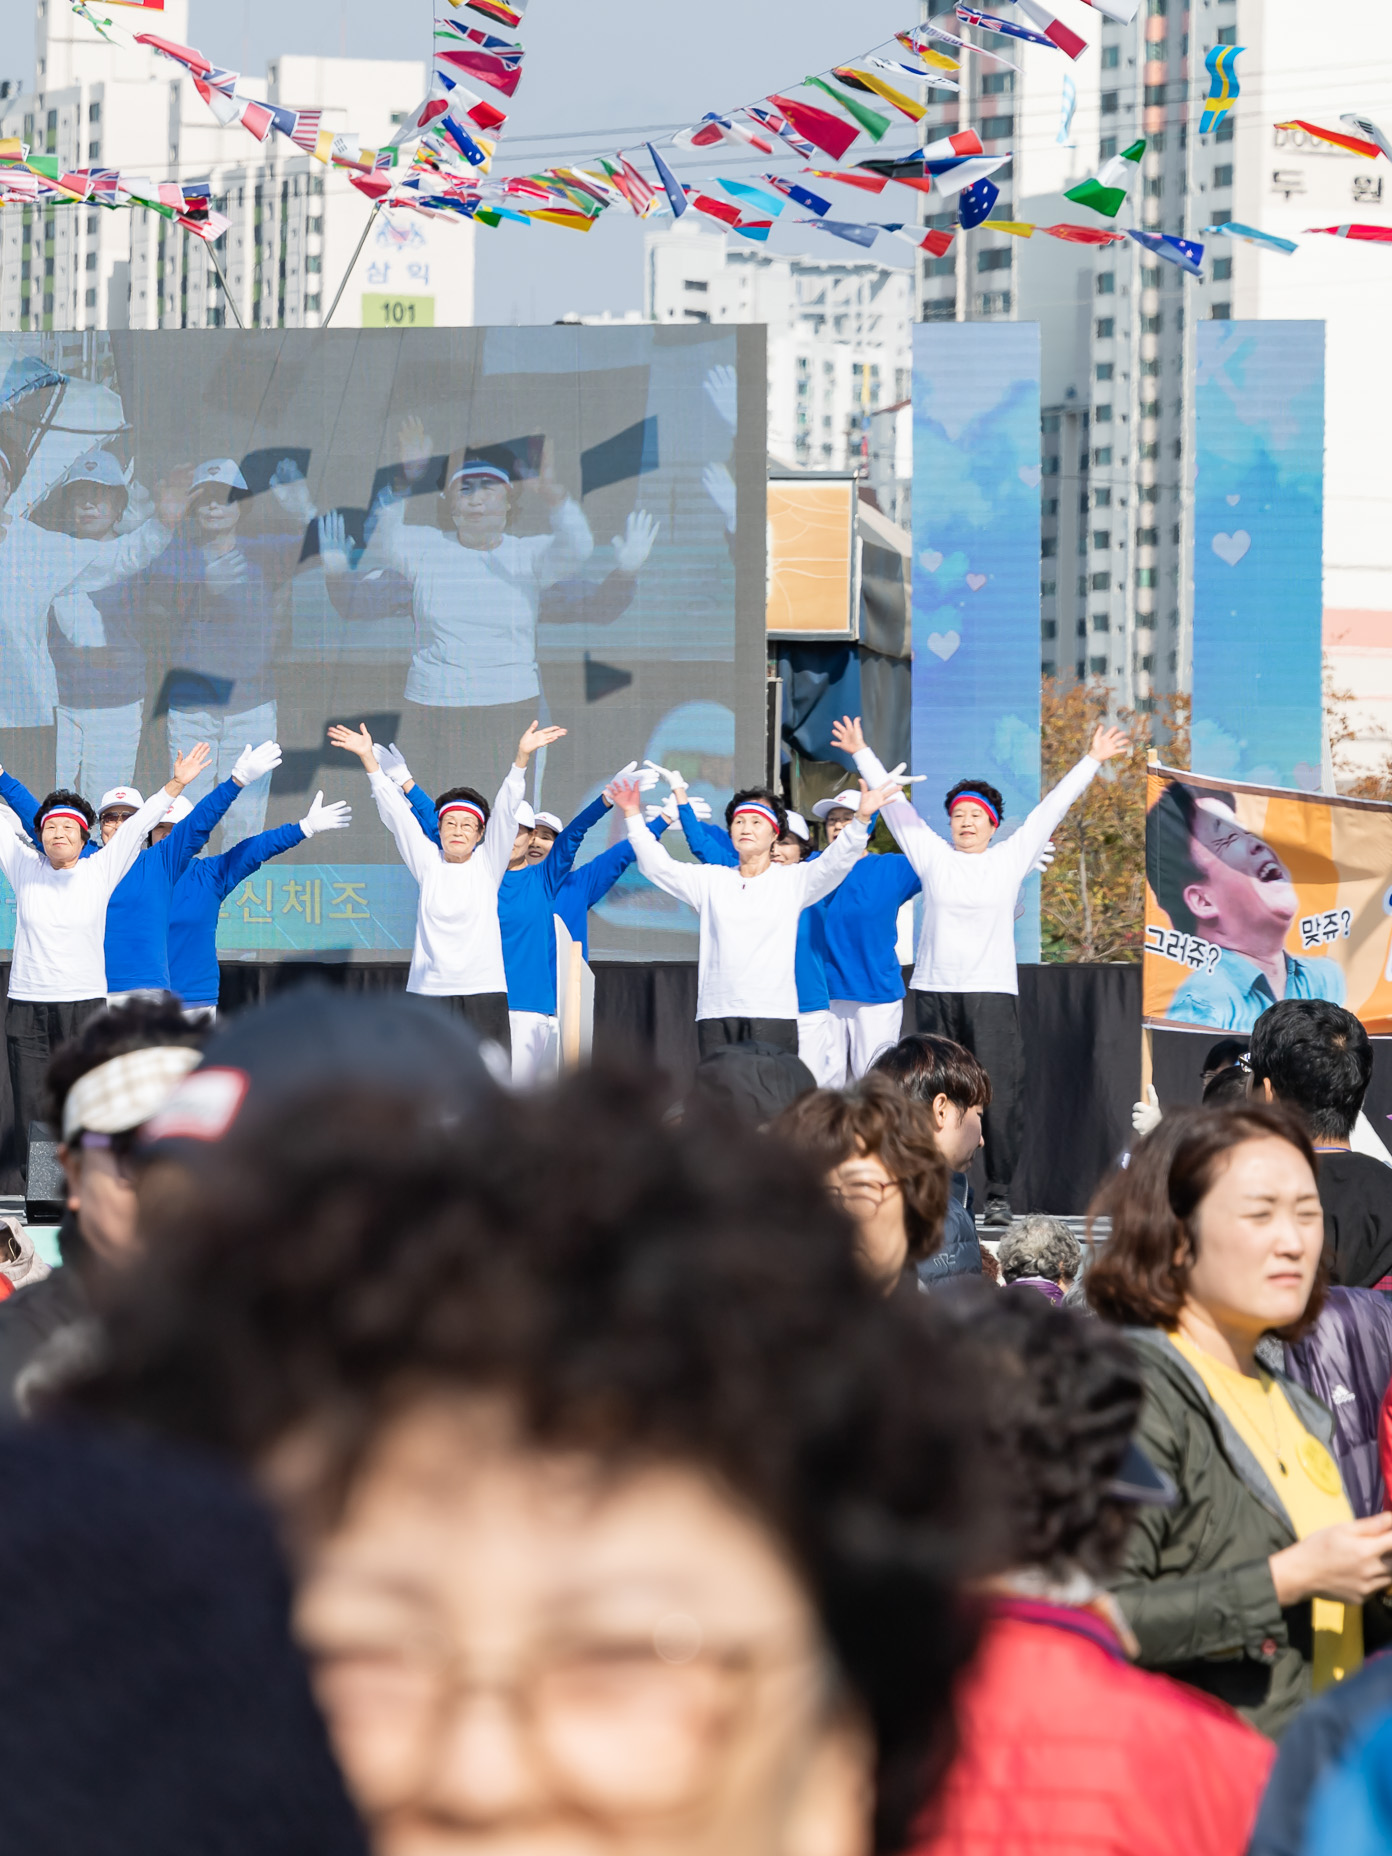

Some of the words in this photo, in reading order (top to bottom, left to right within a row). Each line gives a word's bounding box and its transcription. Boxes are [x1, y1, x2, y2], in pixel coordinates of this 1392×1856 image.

[381, 301, 416, 323] 101
[1144, 926, 1221, 974] 그러쥬?
[1301, 909, 1352, 947] 맞쥬?
